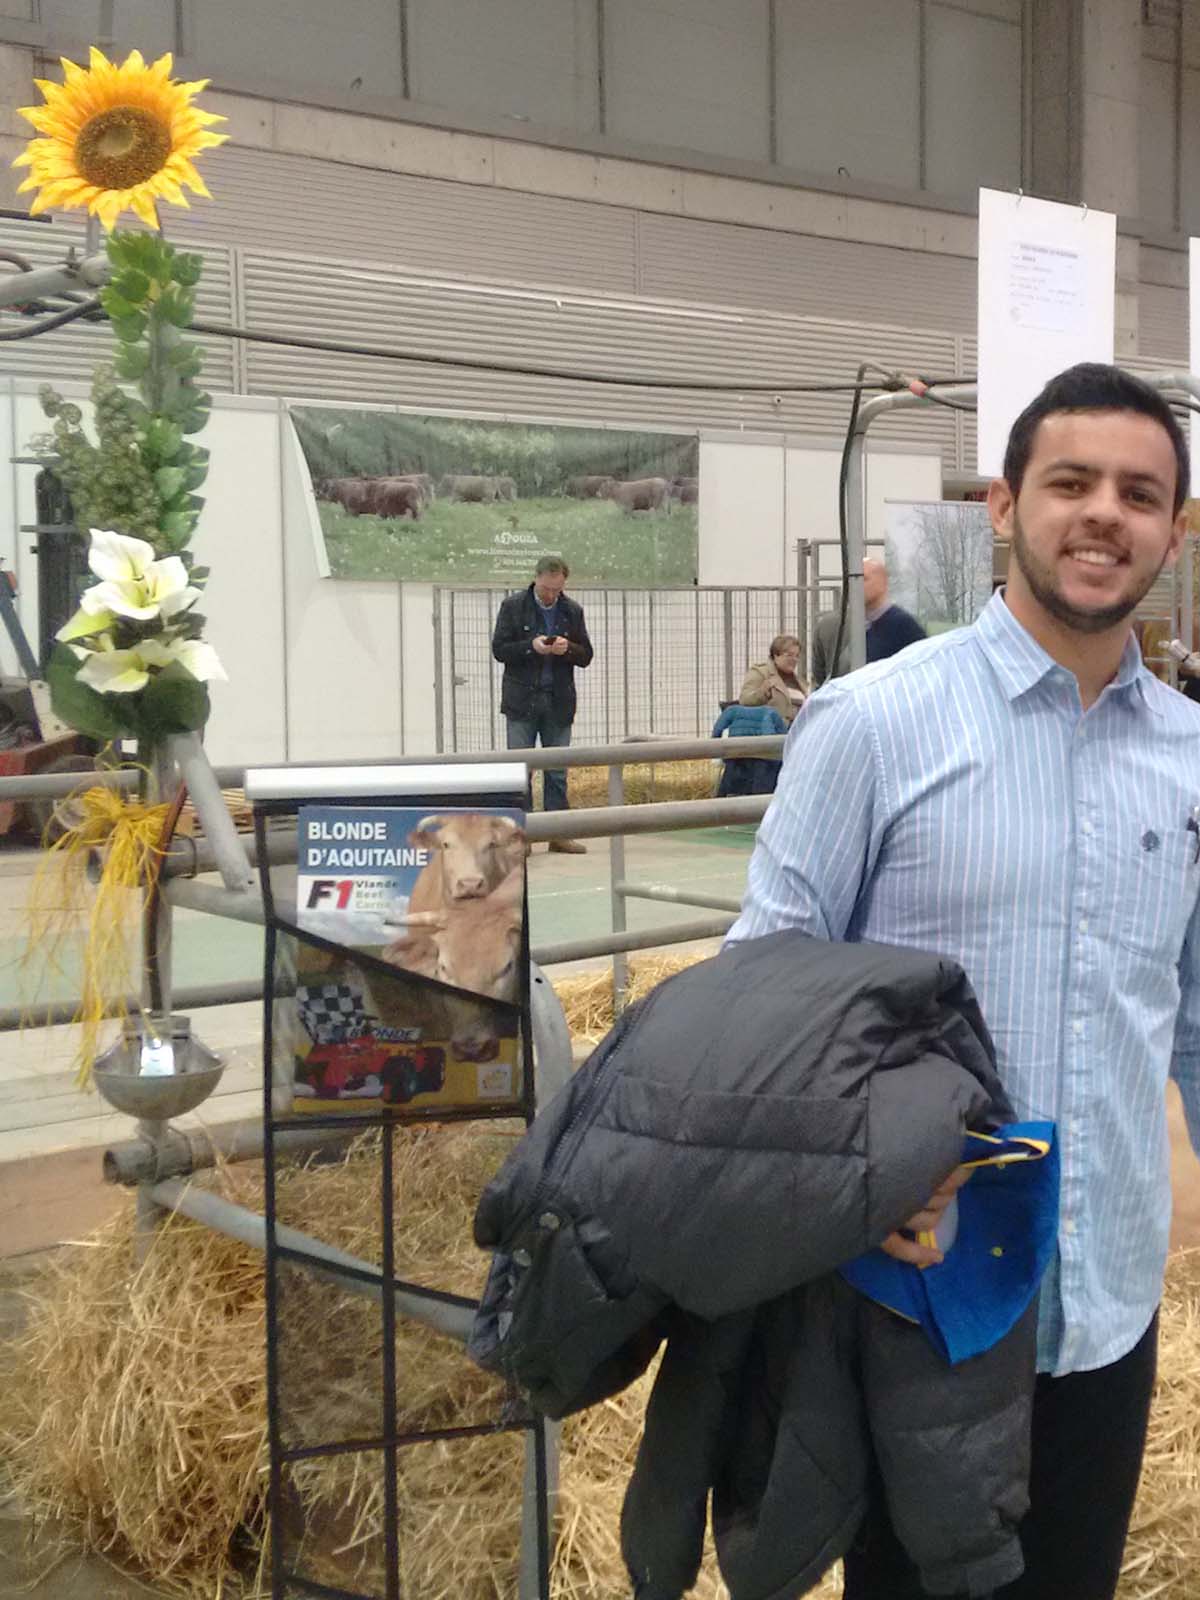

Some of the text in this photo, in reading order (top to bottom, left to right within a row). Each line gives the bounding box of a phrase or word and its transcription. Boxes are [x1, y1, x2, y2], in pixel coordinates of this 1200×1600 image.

[307, 821, 388, 841] BLONDE
[307, 847, 429, 868] D'AQUITAINE
[305, 879, 355, 910] F1
